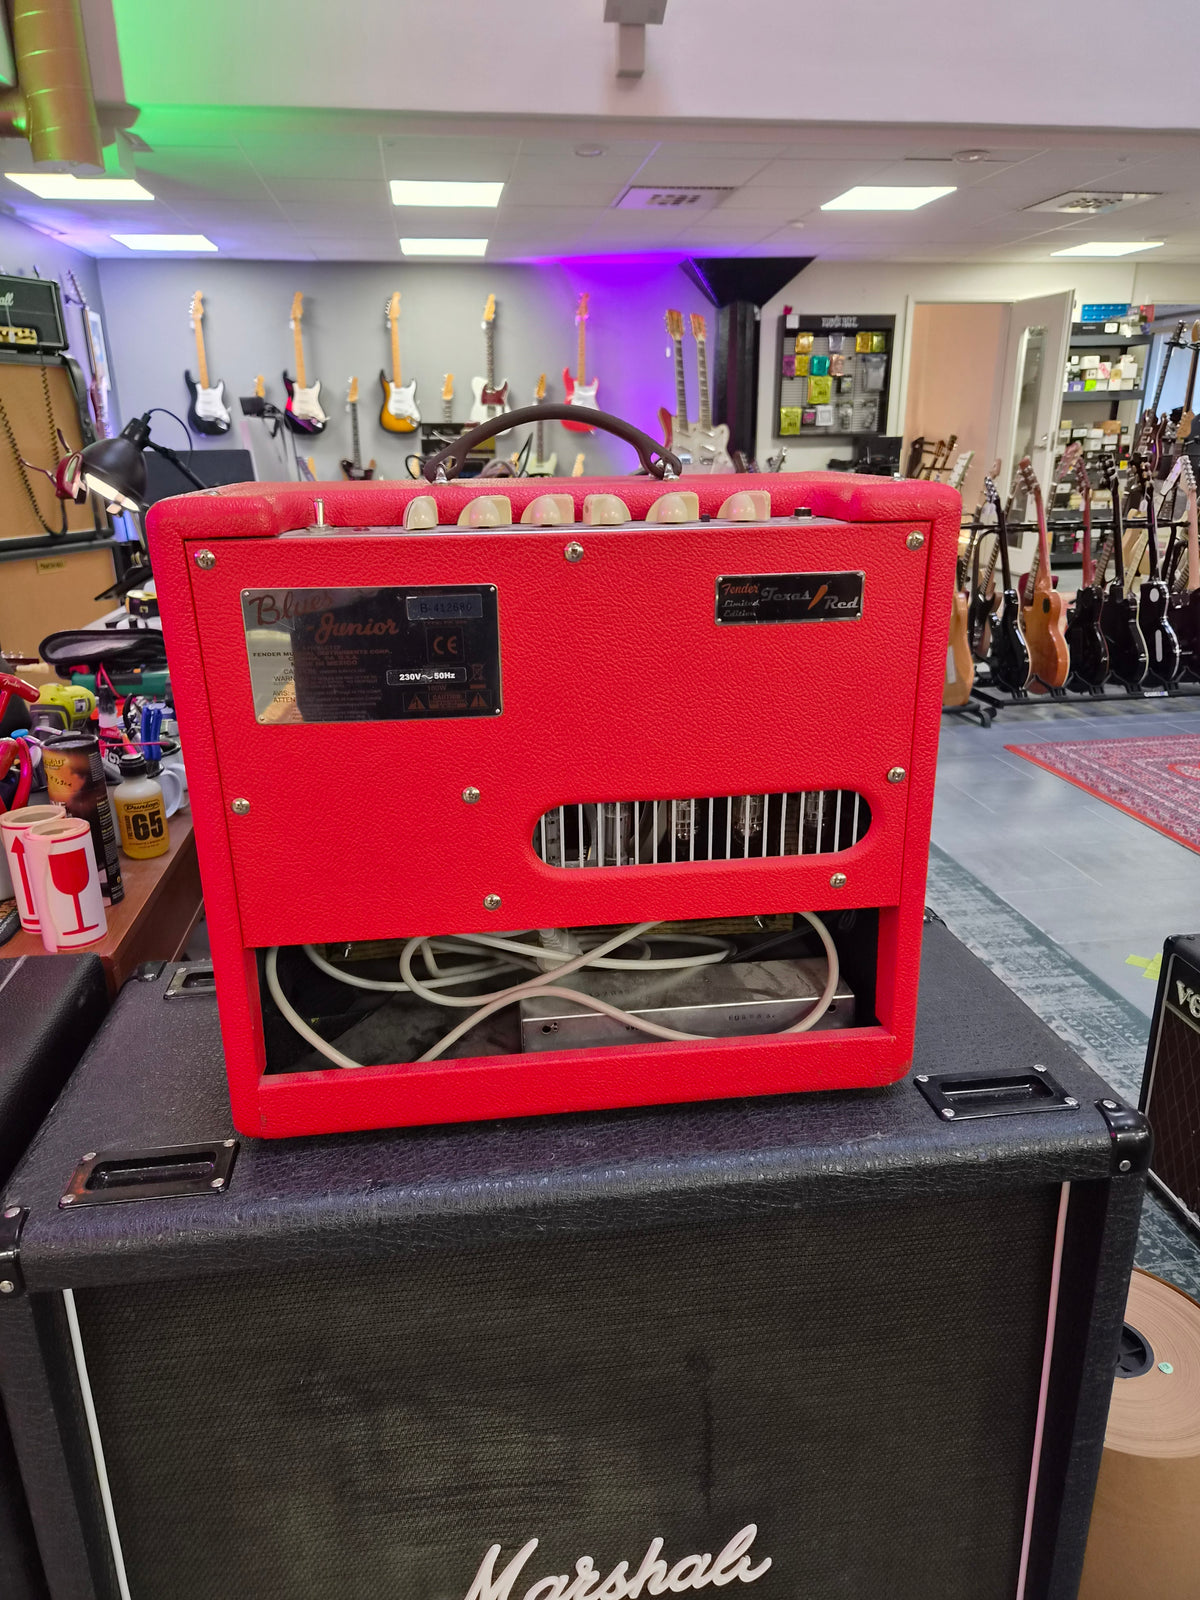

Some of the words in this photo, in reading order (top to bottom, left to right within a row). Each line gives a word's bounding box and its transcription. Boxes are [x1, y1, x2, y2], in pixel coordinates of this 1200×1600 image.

[248, 588, 333, 627] Blues
[721, 583, 759, 595] Fender
[761, 587, 812, 601] Texas
[824, 595, 859, 609] Red
[722, 599, 760, 608] Limited
[310, 612, 399, 644] Junior
[126, 801, 160, 811] Dunlop
[132, 810, 164, 841] 65
